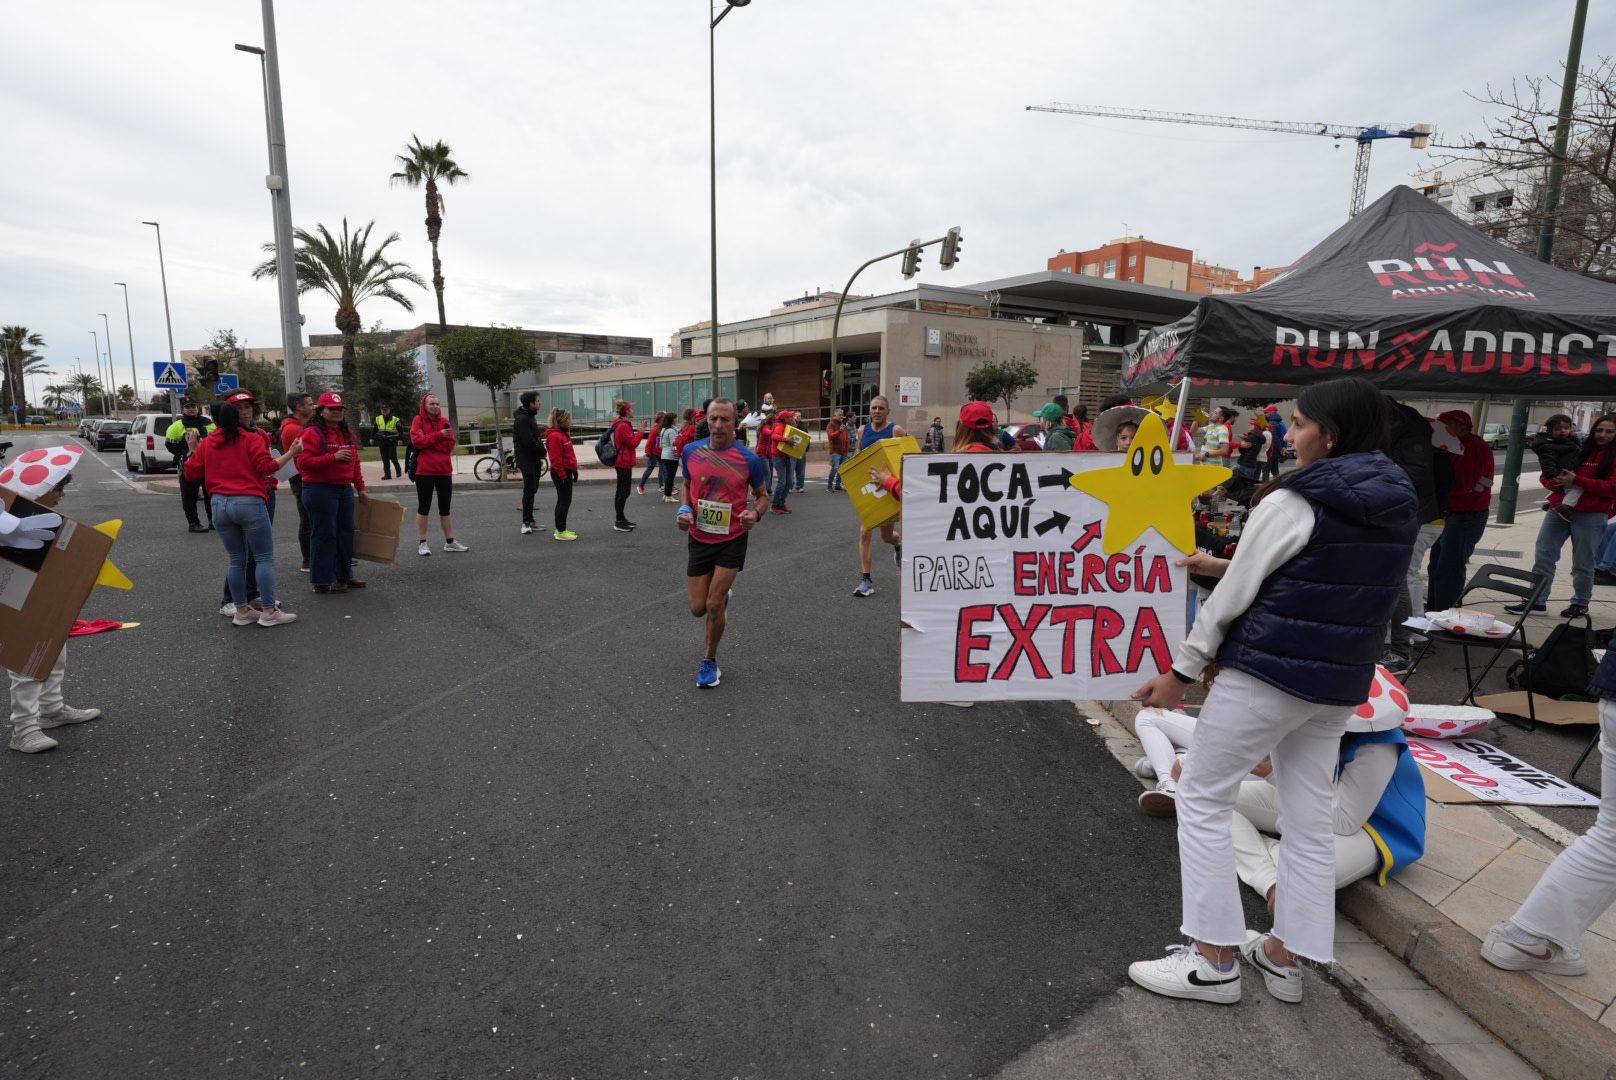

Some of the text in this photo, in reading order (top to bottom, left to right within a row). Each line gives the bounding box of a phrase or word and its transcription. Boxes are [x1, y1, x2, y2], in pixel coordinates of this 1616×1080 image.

[1367, 256, 1527, 289] RUN
[1271, 326, 1380, 370] RUN
[928, 462, 1034, 503] TOCA
[703, 509, 722, 521] 970
[946, 499, 1036, 541] AQUÍ
[913, 545, 1172, 596] PARA ENERGÍA
[955, 603, 1174, 683] EXTRA
